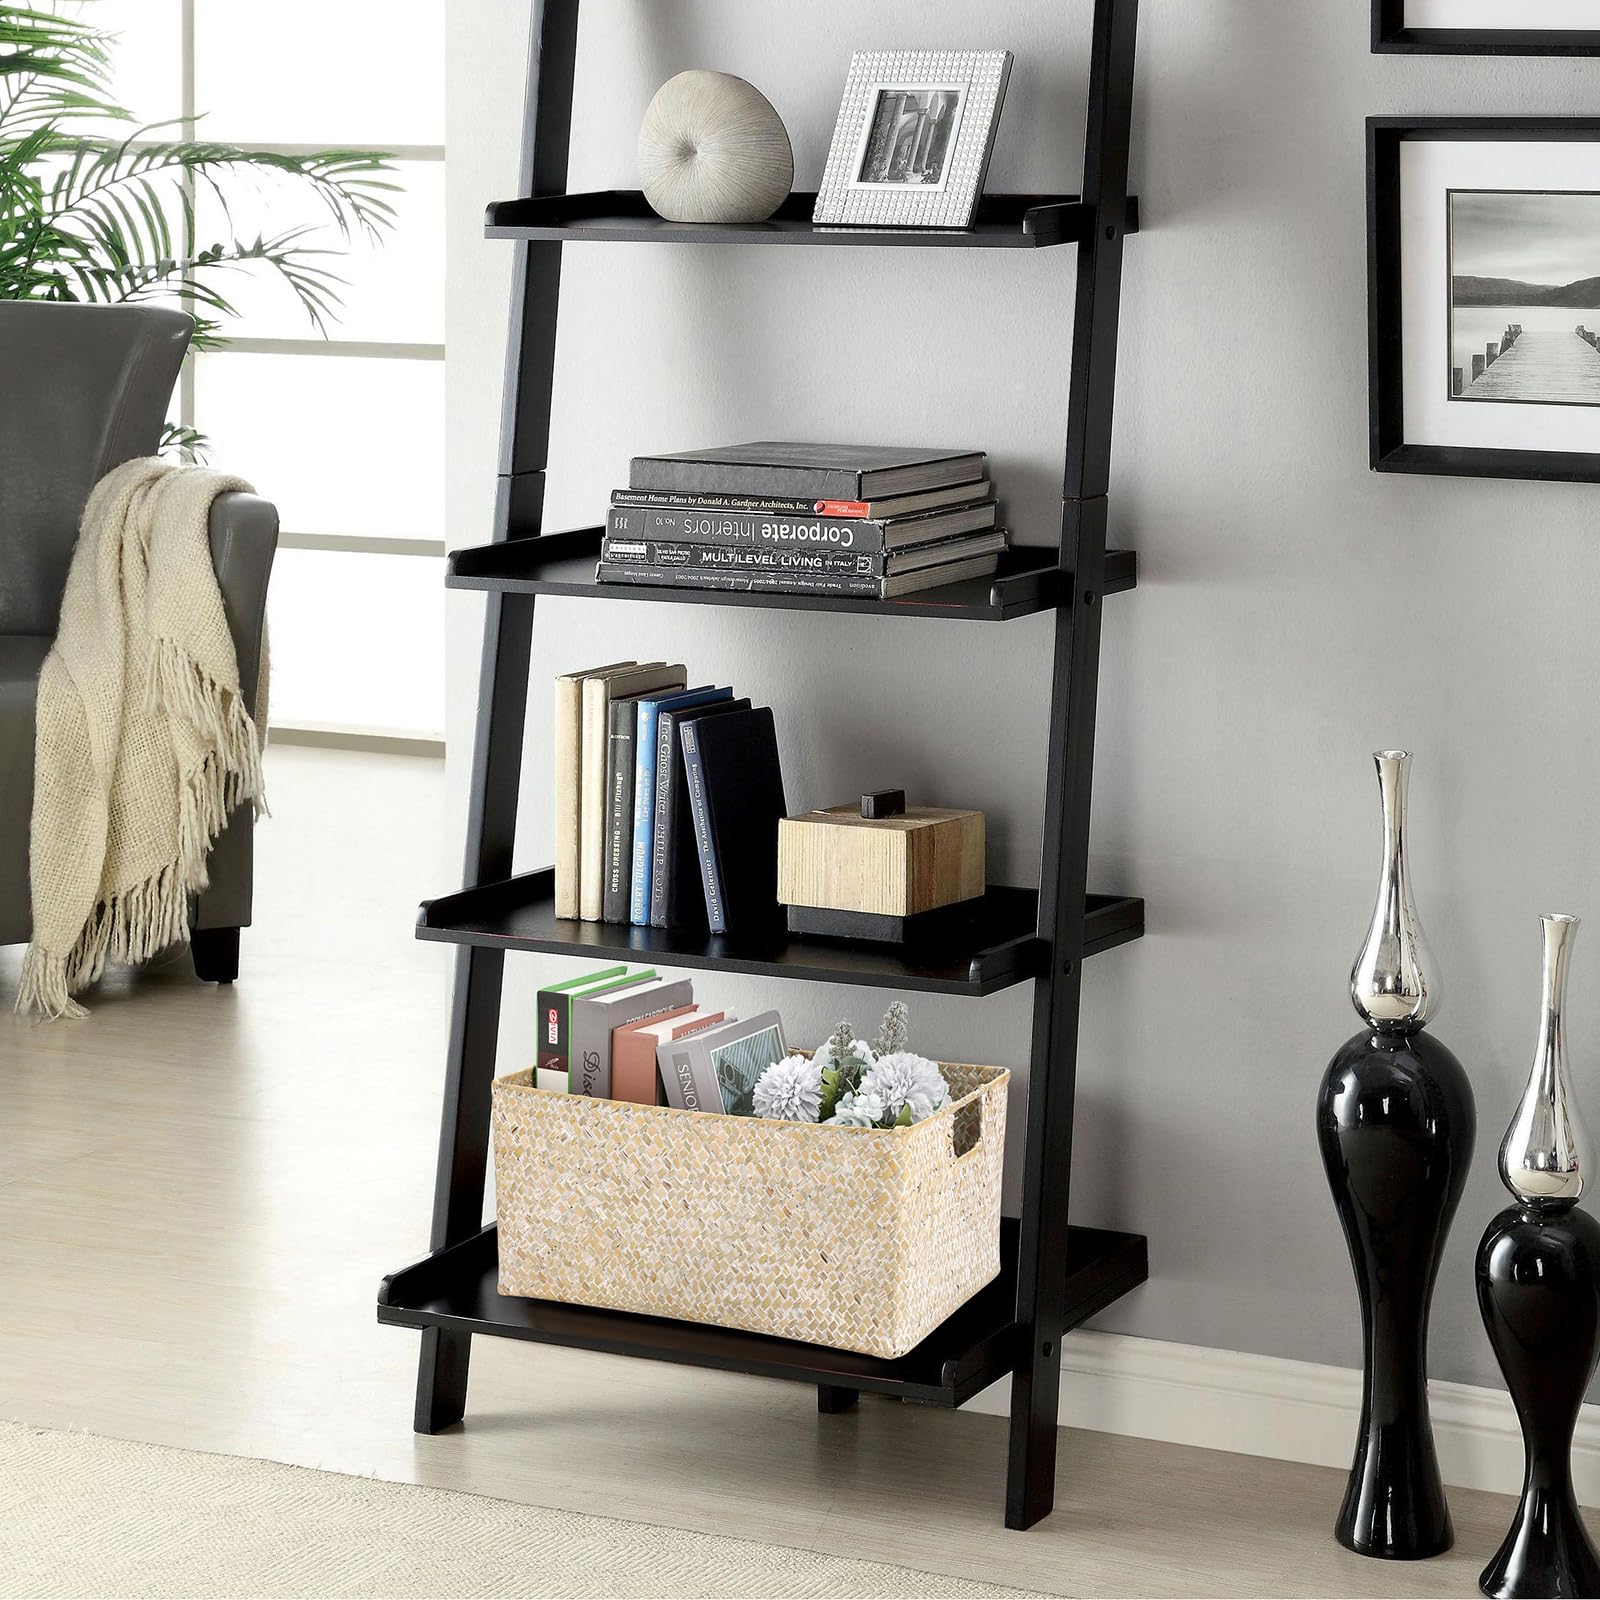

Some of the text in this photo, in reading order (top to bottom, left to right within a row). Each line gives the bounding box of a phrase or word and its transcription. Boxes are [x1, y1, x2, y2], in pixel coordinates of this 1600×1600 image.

[615, 493, 809, 510] Basement Home Plans by Donald A. Gardner Architects, Inc.
[684, 518, 756, 542] Interiors
[761, 522, 854, 547] Corporate
[702, 552, 777, 565] MULTILEVEL
[781, 556, 823, 567] LIVING
[657, 718, 671, 815] The Ghost Writer
[690, 763, 701, 798] Computing
[612, 772, 623, 893] CROSS DRESSING Bill Fitzhugh
[698, 808, 707, 839] Aesthetics
[656, 824, 665, 864] PHILIP
[634, 841, 646, 920] ROBERT FULGHUM
[705, 859, 720, 922] David Gelernter
